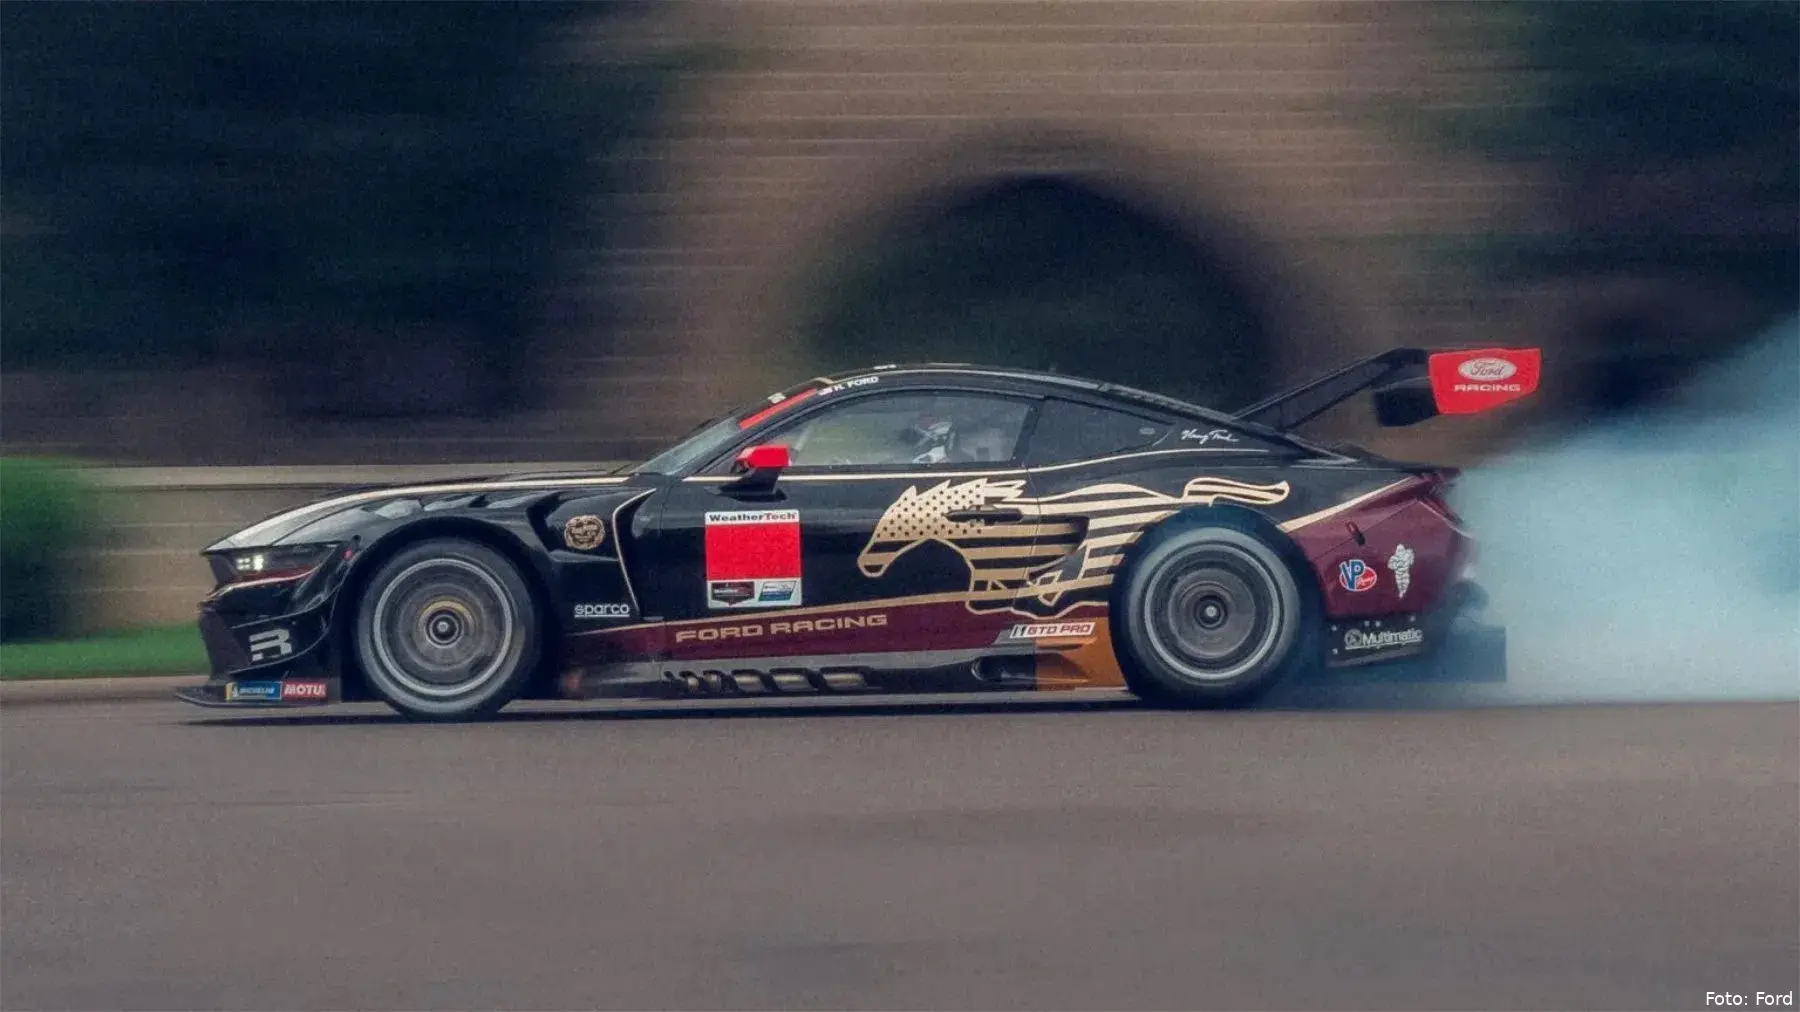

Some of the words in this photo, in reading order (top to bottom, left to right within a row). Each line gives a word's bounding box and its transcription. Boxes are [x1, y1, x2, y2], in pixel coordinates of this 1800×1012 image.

[1471, 361, 1505, 376] Ford
[848, 376, 879, 388] FORD
[1453, 384, 1521, 392] RACING
[709, 512, 796, 522] WeatherTech
[1339, 559, 1365, 590] VP
[574, 603, 630, 618] sparco
[675, 624, 763, 643] FORD
[770, 614, 888, 635] RACING
[1027, 625, 1057, 635] GTD
[1059, 624, 1091, 634] PRO
[1362, 628, 1423, 648] Multimatic
